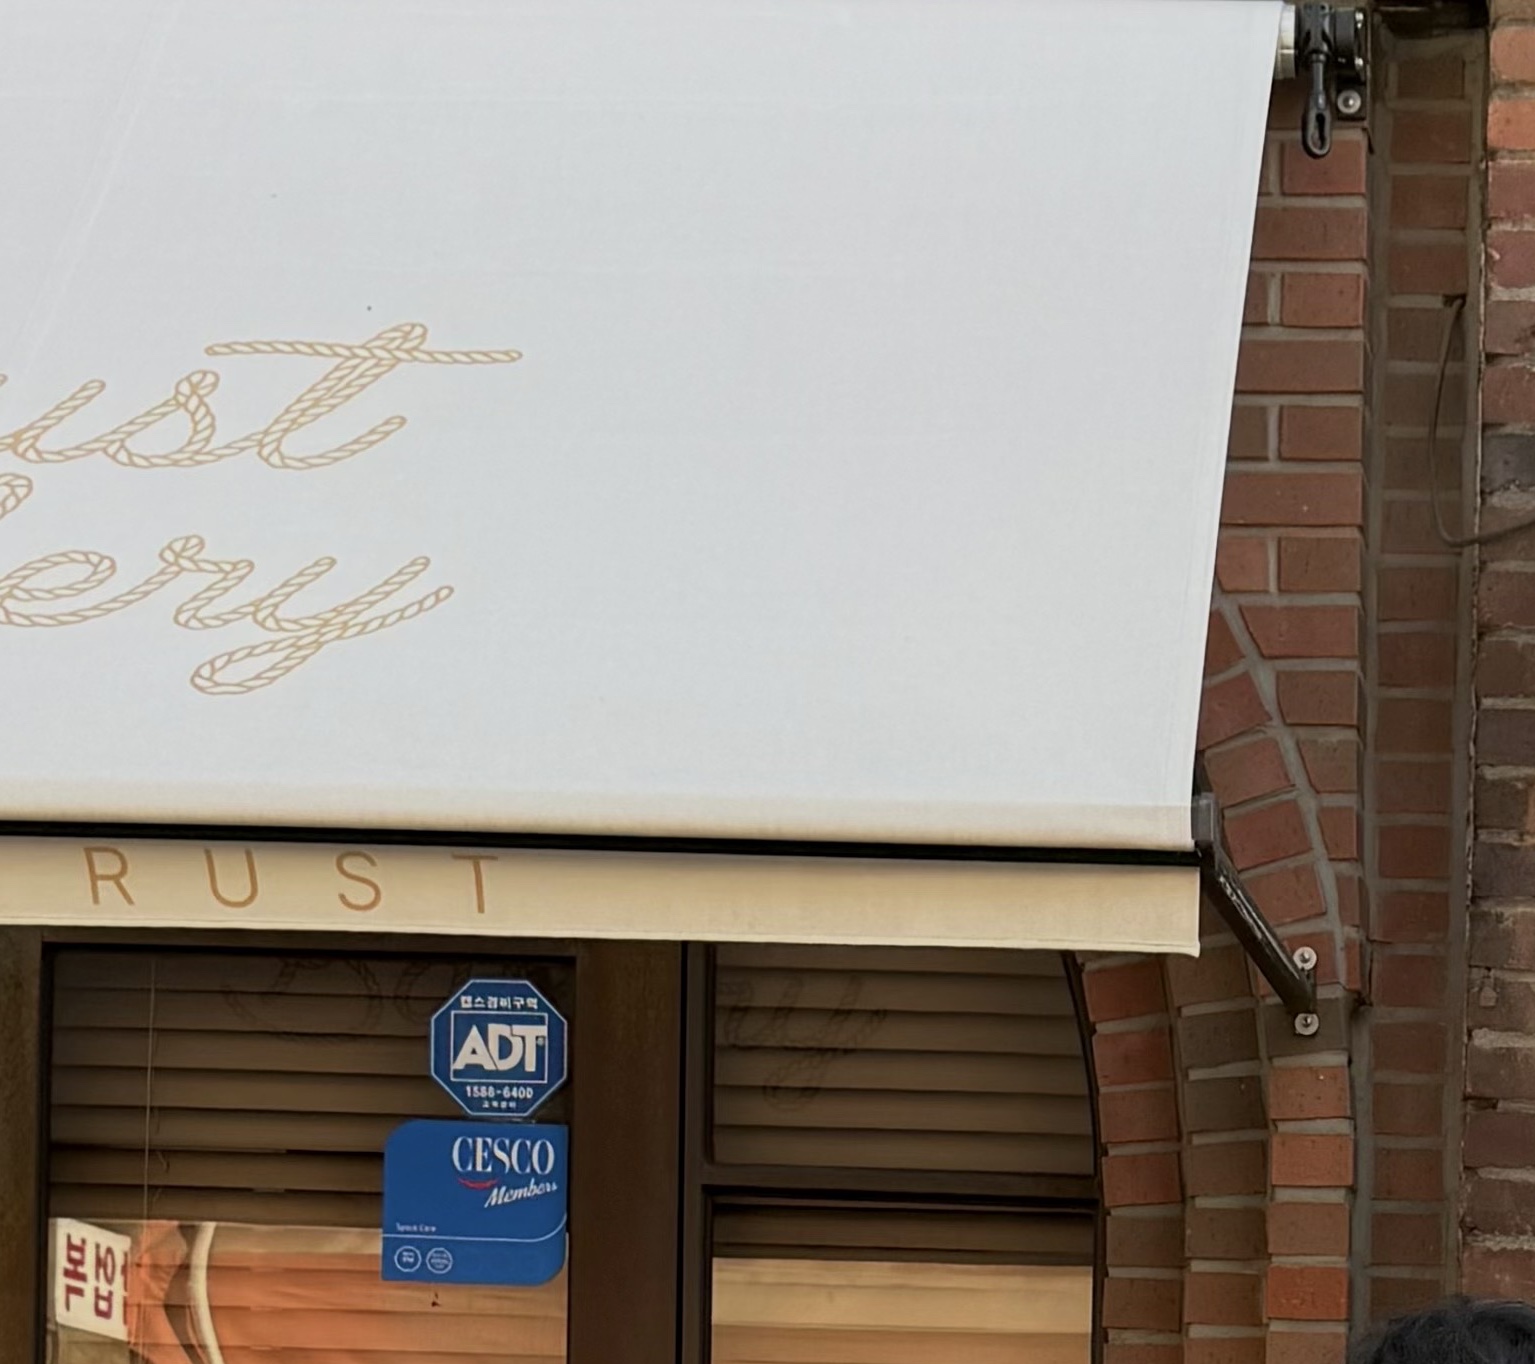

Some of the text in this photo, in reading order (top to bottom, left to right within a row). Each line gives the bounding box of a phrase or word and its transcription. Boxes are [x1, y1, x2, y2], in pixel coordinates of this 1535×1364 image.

[0, 474, 454, 695] ery
[82, 844, 499, 916] RUST
[451, 1022, 548, 1073] ADT
[465, 1085, 534, 1099] 1588-6400
[452, 1136, 556, 1175] CESCO
[483, 1178, 558, 1209] Members
